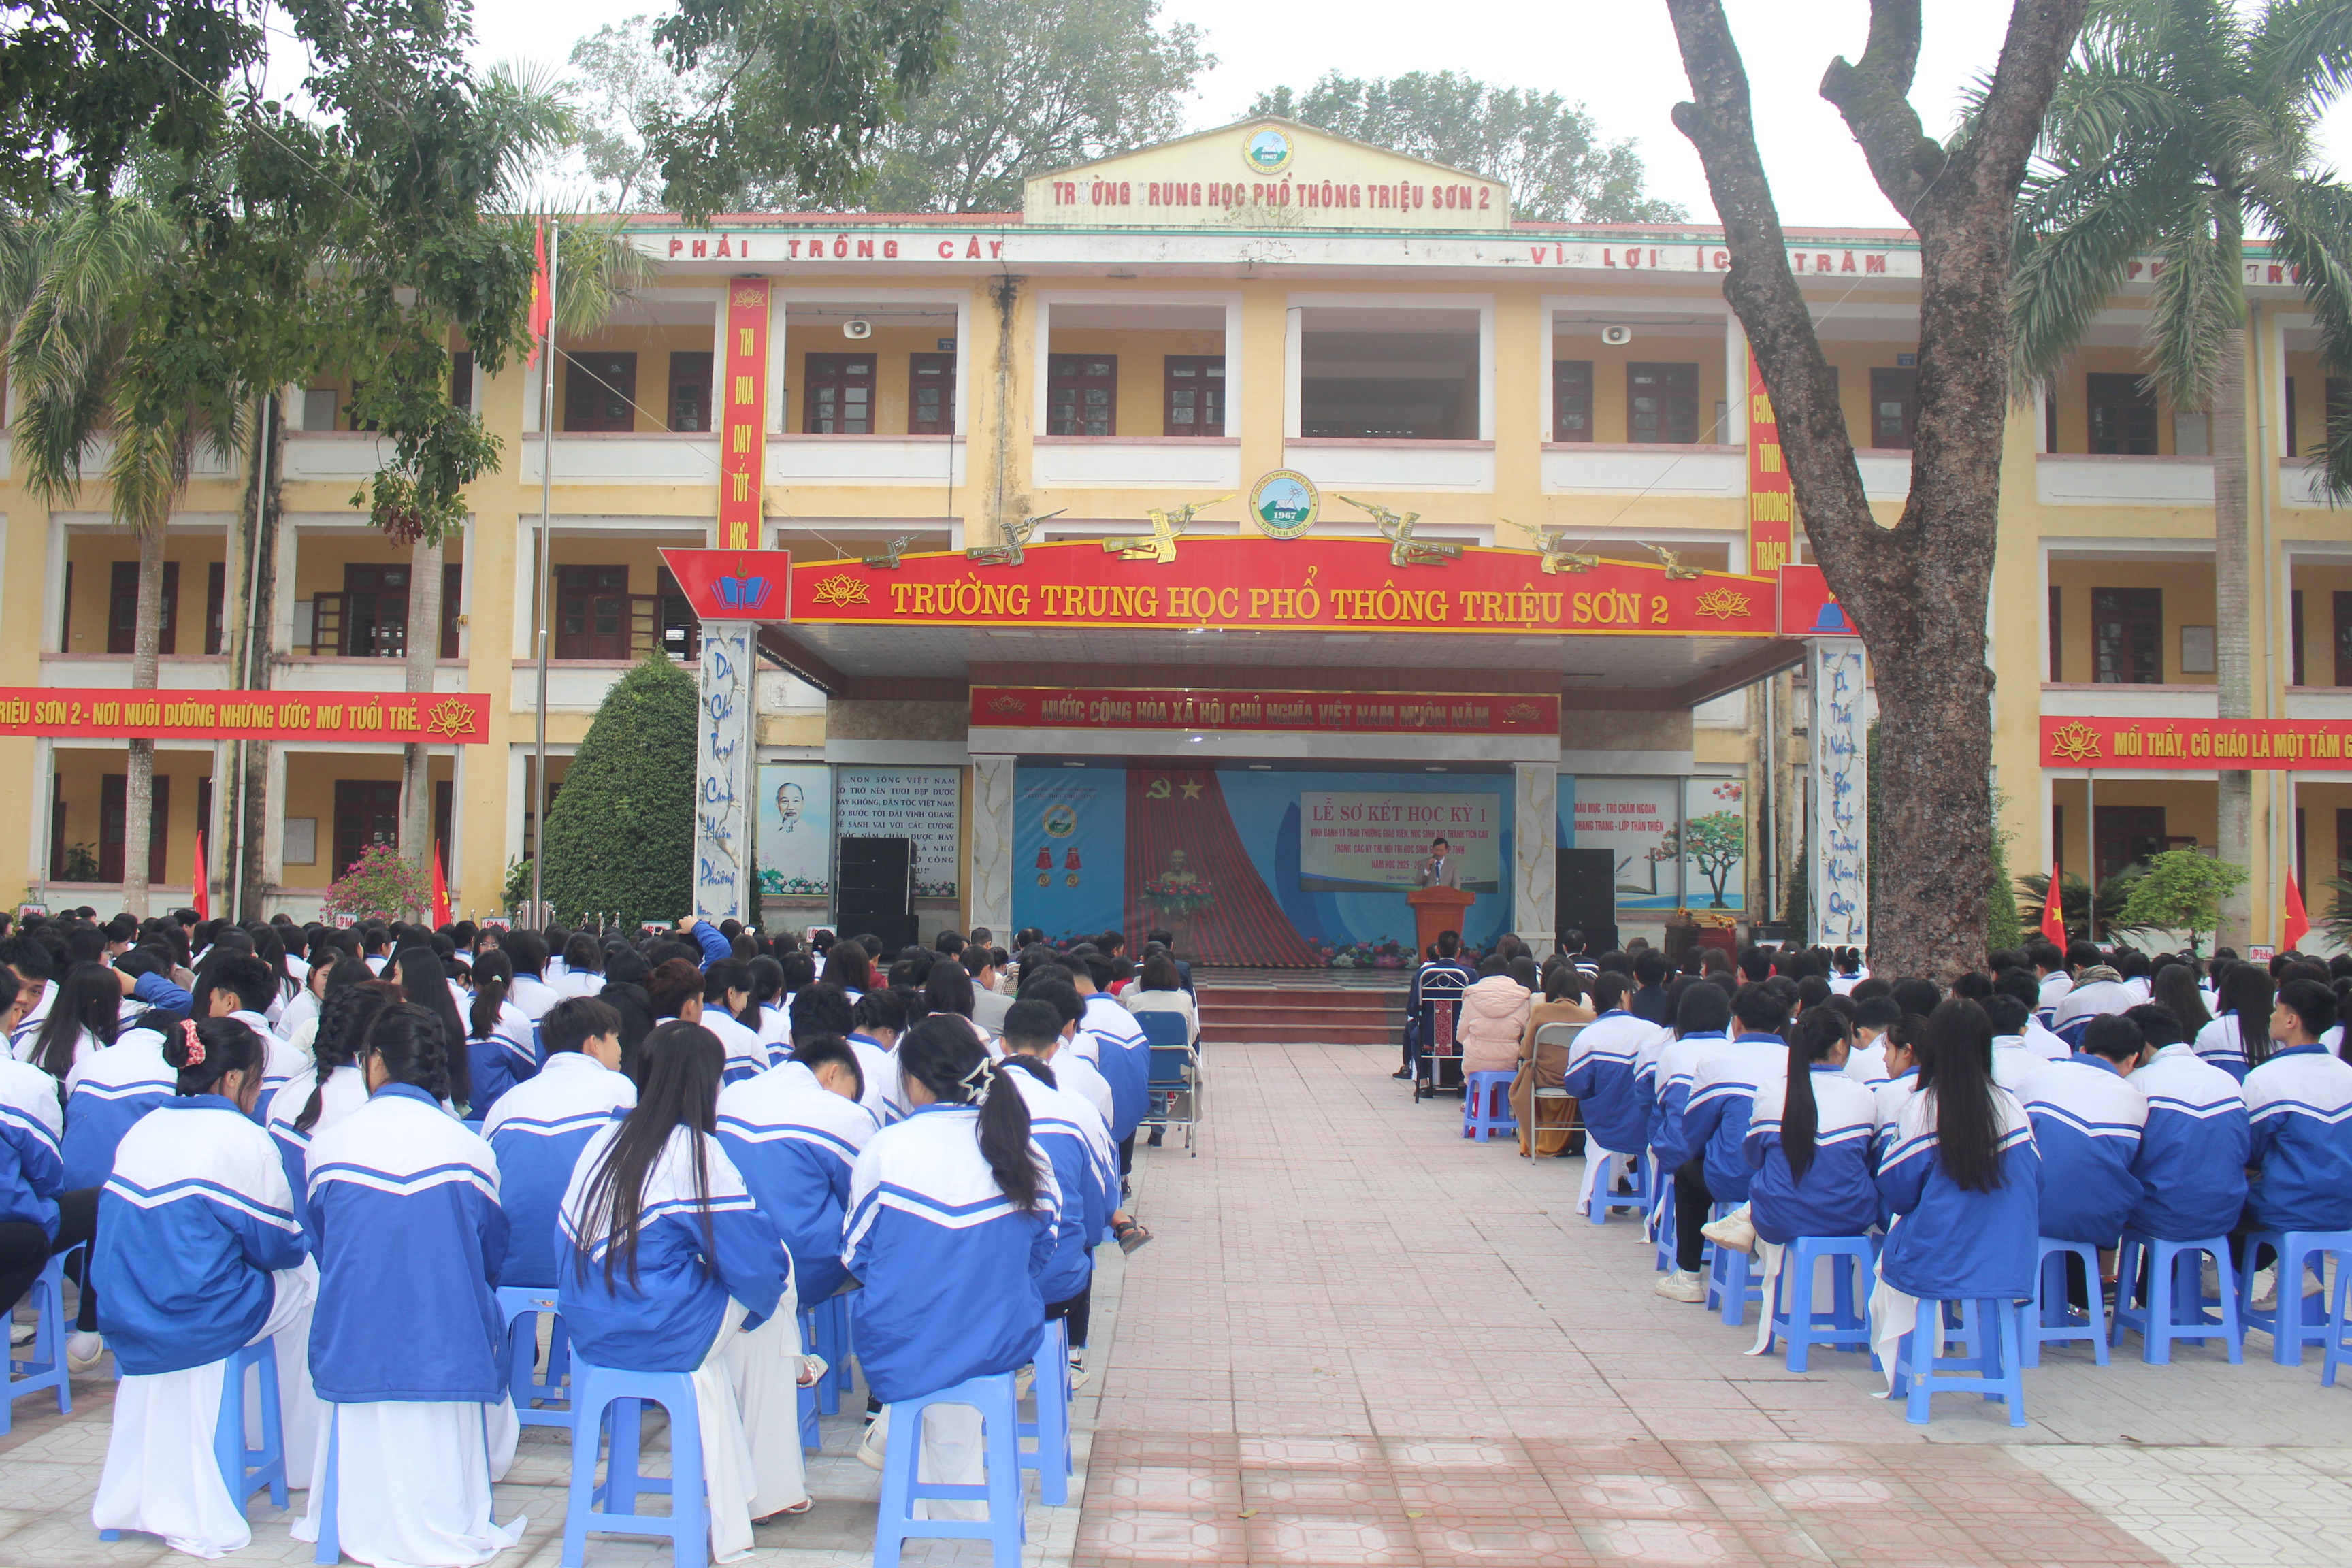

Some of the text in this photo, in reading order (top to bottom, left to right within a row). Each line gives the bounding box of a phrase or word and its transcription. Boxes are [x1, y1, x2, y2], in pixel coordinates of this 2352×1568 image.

[1209, 182, 1246, 210] HỌC
[1253, 172, 1292, 206] PHỔ
[1297, 179, 1361, 208] THÔNG
[1368, 180, 1424, 212] TRIỆU
[1433, 184, 1472, 209] SƠN
[1479, 186, 1490, 209] 2
[669, 233, 748, 257] PHẢI
[938, 235, 1004, 259] CÂY
[1531, 242, 1564, 265] VÌ
[1603, 246, 1657, 267] LỢI
[1697, 246, 1731, 269] ÍC
[1795, 250, 1887, 272] TRĂM
[740, 327, 755, 357] THI
[735, 376, 754, 405] ĐUA
[733, 424, 753, 459] DẠY
[1759, 438, 1781, 472] TÌNH
[733, 462, 750, 502] TỐT
[1273, 511, 1297, 519] 1967
[1752, 489, 1789, 521] THƯƠNG
[1261, 521, 1288, 536] THANH
[1756, 535, 1787, 570] TRÁCH
[890, 566, 1669, 630] TRƯỜNG TRUNG HỌC PHỔ THÔNG TRIỆU SƠN 2
[35, 700, 67, 725] SƠN
[71, 703, 81, 725] 2
[93, 701, 120, 726] NƠI
[124, 698, 161, 727] NUÔI
[164, 697, 215, 728] DƯỠNG
[278, 699, 311, 729] ƯỚC
[316, 704, 343, 730] MƠ
[348, 695, 382, 730] TUỔI
[389, 697, 421, 730] TRẺ.
[711, 693, 733, 720] Cho
[1041, 694, 1490, 730] NƯỚC CỘNG HÒA XÃ HỘI CHỦ NGHĨA VIỆT NAM MUÔN NĂM
[2114, 723, 2142, 756] MỖI
[2147, 724, 2187, 759] THẦY,
[2191, 728, 2210, 757] CÔ
[2214, 729, 2247, 757] GIÁO
[2252, 729, 2270, 758] LÀ
[2274, 729, 2304, 762] MỘT
[2308, 725, 2340, 758] TẤM
[706, 777, 735, 803] Cánh
[906, 777, 928, 785] VIỆT
[933, 789, 955, 797] ĐƯỢC
[852, 798, 881, 806] KHÔNG,
[901, 798, 916, 807] TỘC
[918, 798, 935, 808] VIỆT
[872, 808, 885, 817] TỚI
[1313, 797, 1486, 826] LỄ SƠ KẾT HỌC KỲ 1
[1588, 802, 1601, 815] MỰC
[1606, 801, 1617, 813] TRÒ
[1637, 804, 1656, 814] NGOAN
[706, 814, 732, 845] Muôn
[890, 820, 903, 828] VỚI
[908, 821, 923, 829] CÁC
[927, 821, 954, 830] CƯỜNG
[911, 834, 934, 843] ĐƯỢC
[1311, 828, 1323, 837] VINH
[1324, 828, 1338, 837] DANH
[1348, 828, 1360, 837] TRAO
[1411, 830, 1421, 840] HỌC
[1422, 830, 1435, 838] SINH
[1478, 830, 1488, 838] CAO
[1574, 821, 1593, 830] KHANG
[1595, 821, 1614, 831] TRANG
[1647, 819, 1663, 833] THIỆN
[1334, 844, 1351, 853] TRONG
[1416, 845, 1428, 853] SINH
